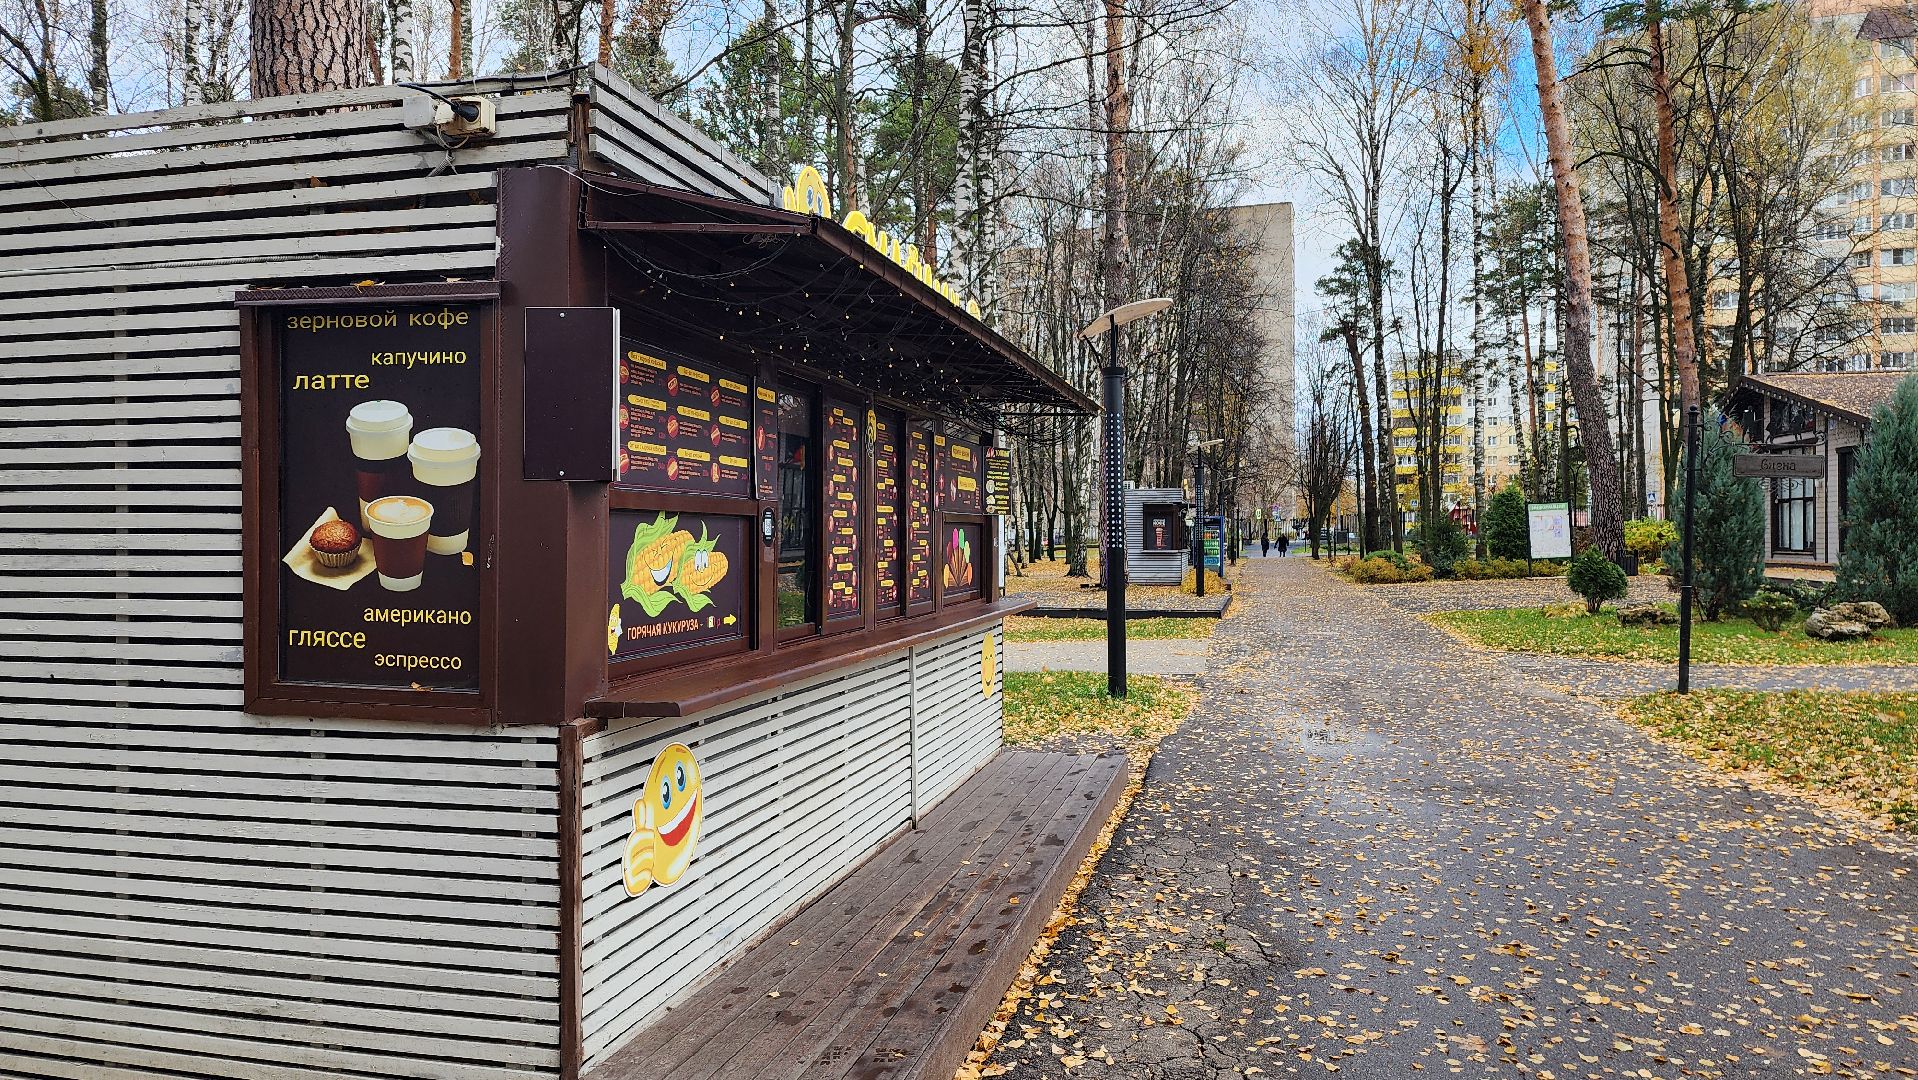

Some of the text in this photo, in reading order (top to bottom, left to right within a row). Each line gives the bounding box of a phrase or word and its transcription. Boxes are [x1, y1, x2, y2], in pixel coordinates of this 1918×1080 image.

[287, 308, 469, 332] зерновой кофе
[371, 351, 467, 369] капучино
[292, 374, 370, 390] латте
[363, 607, 472, 627] американо
[289, 630, 366, 649] гляссе
[627, 622, 661, 640] ГОРЯЧАЯ
[374, 653, 462, 671] эспрессо
